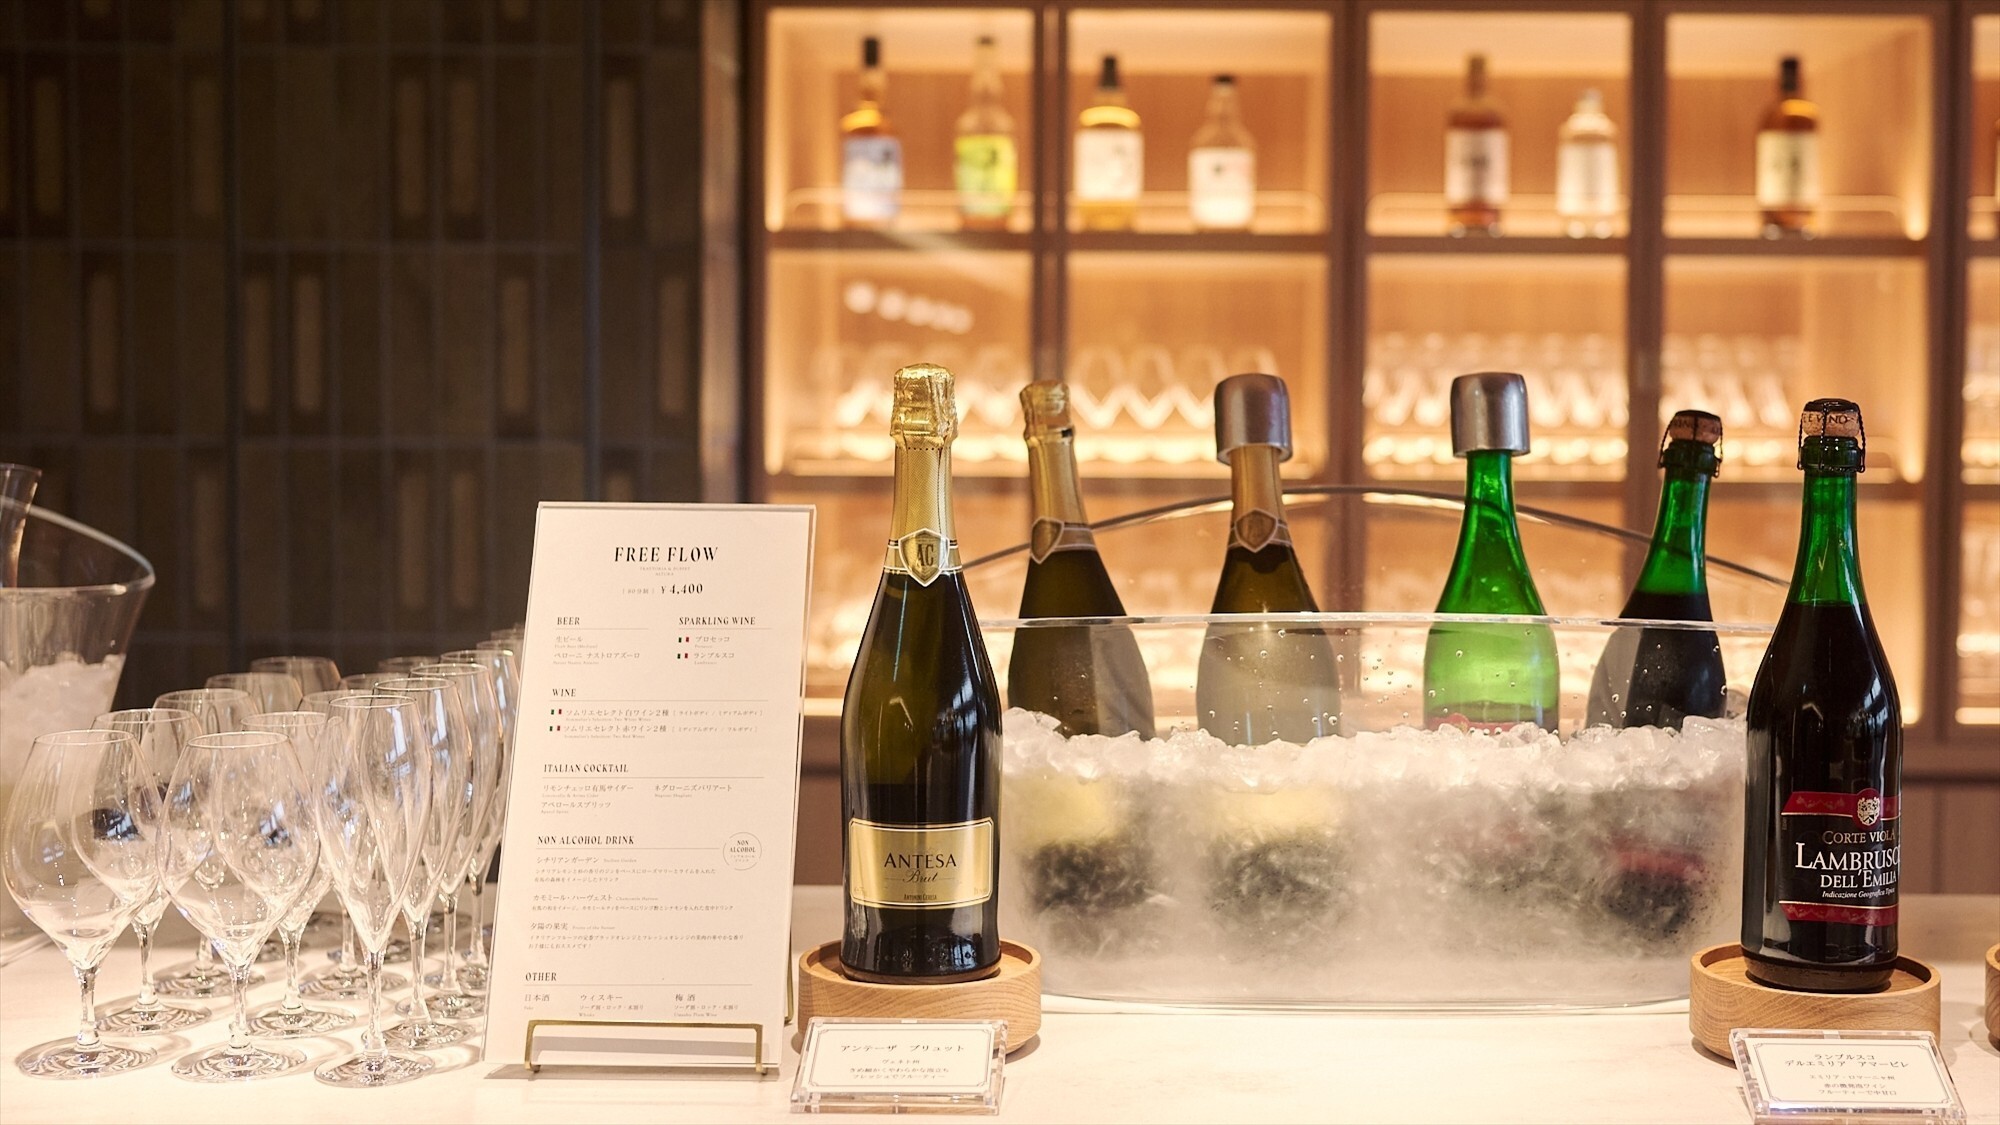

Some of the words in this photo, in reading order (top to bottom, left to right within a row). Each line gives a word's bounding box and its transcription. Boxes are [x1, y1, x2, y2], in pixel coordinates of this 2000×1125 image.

[614, 546, 661, 562] FREE
[667, 546, 719, 562] FLOW
[916, 543, 935, 567] AC
[556, 616, 581, 626] BEER
[679, 616, 729, 626] SPARKLING
[731, 616, 756, 626] WINE
[555, 635, 583, 643] 生ビール
[695, 635, 731, 643] プロセッコ
[693, 652, 735, 660] ランブルスコ
[552, 688, 577, 698] WINE
[544, 763, 581, 773] ITALIAN
[583, 763, 629, 773] COCKTAIL
[537, 835, 557, 845] NON
[559, 835, 603, 845] ALCOHOL
[605, 835, 635, 845] DRINK
[1822, 830, 1867, 845] CORTE
[1869, 829, 1896, 842] VIOLA
[883, 852, 957, 869] ANTESA
[903, 869, 939, 883] Brut
[1822, 891, 1858, 899] Indicazione
[530, 922, 568, 931] 夕陽の果実
[525, 972, 557, 982] OTHER
[524, 993, 550, 1002] 日本酒
[580, 994, 623, 1002] ウィスキー
[841, 1044, 897, 1052] アンテーザ
[1814, 1053, 1875, 1061] ランブルスコ
[1784, 1059, 1845, 1068] デルエミリア
[1858, 1060, 1909, 1068] アマービレ
